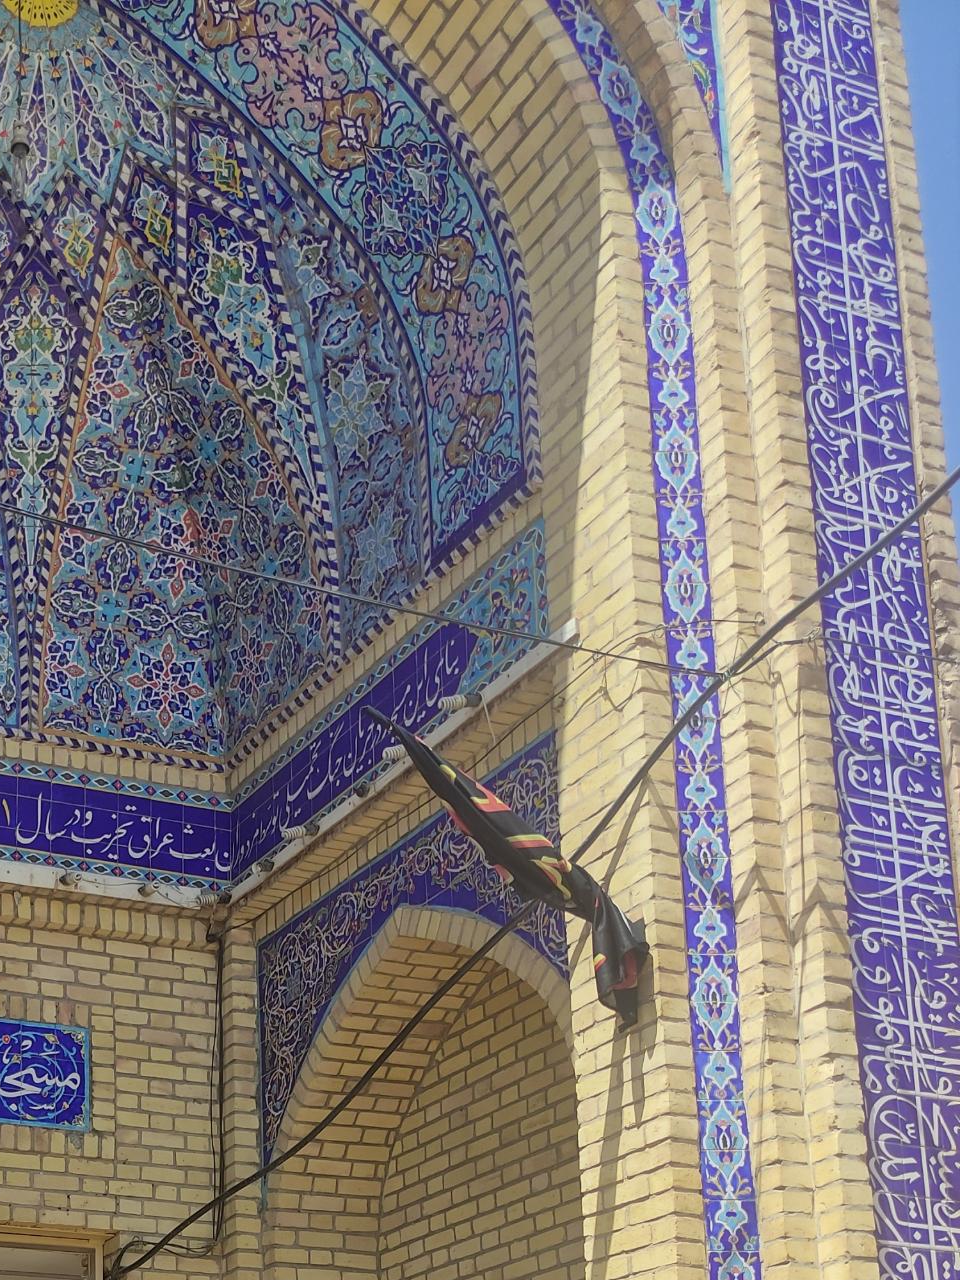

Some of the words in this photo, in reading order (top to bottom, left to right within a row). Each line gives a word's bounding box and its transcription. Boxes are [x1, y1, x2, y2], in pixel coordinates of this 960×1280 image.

[15, 792, 68, 844] سال
[71, 804, 138, 860] تخریب
[128, 816, 174, 860] عراق
